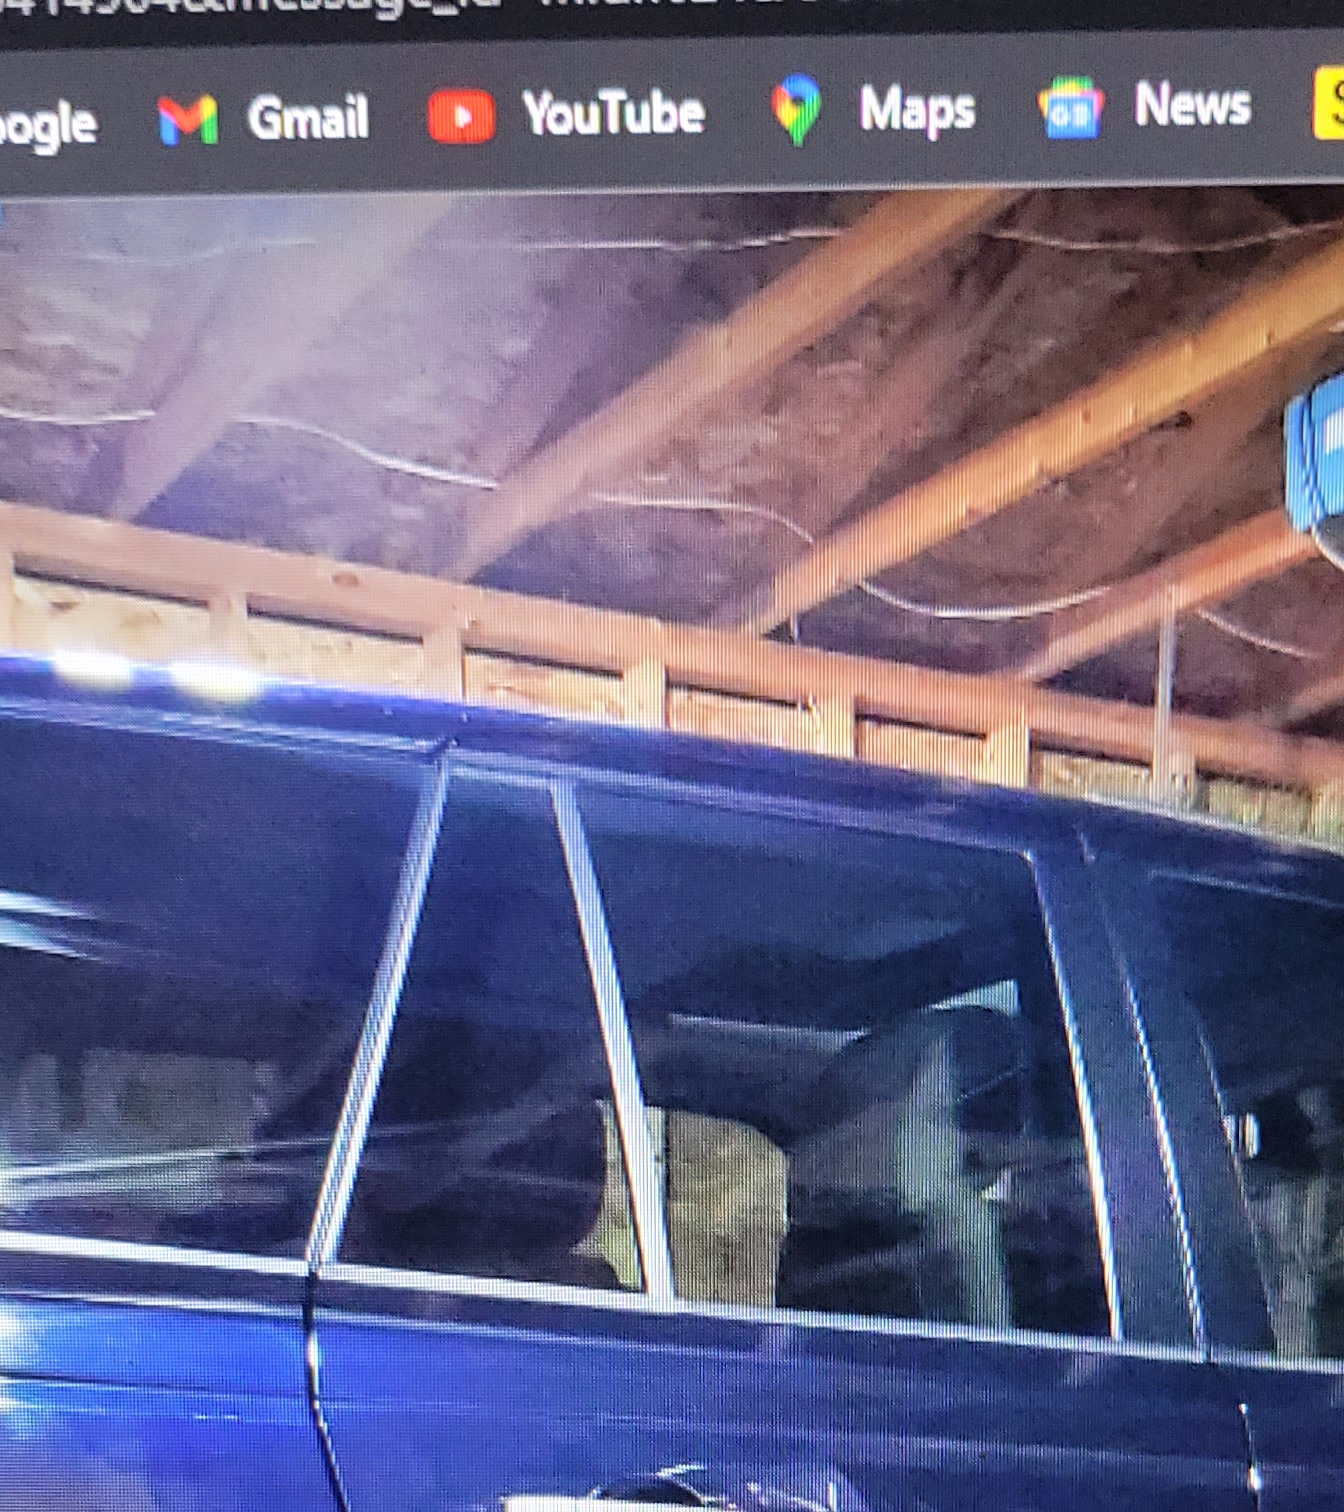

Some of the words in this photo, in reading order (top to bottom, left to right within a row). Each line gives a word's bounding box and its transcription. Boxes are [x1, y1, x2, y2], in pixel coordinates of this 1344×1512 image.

[247, 92, 369, 140] Gmail
[521, 87, 706, 136] YouTube
[860, 82, 976, 142] Maps
[1135, 79, 1252, 127] News
